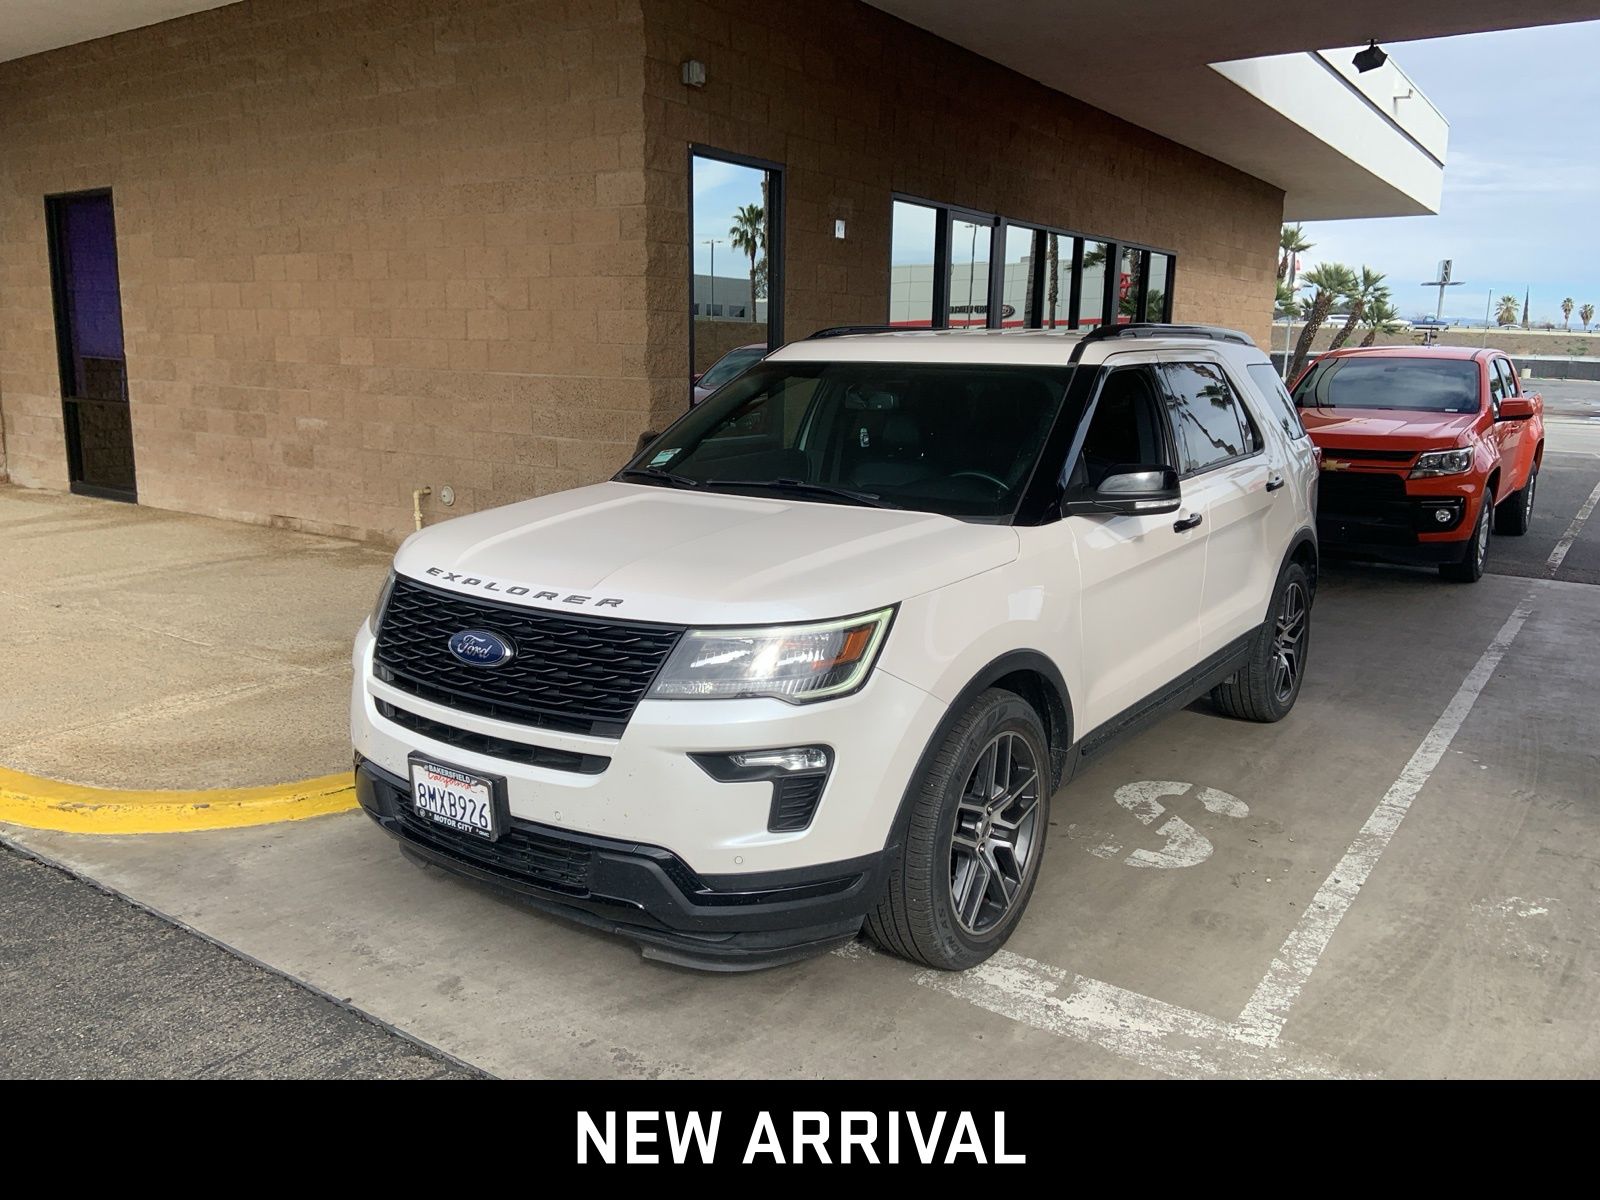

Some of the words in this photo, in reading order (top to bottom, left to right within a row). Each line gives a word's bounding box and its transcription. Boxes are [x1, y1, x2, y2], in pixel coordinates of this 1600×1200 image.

[426, 566, 624, 608] EXPLORER
[456, 633, 494, 660] Ford
[428, 764, 471, 784] BAKERSFIELD
[417, 783, 488, 829] 8MXB926
[433, 813, 456, 828] MOTOR
[457, 822, 473, 833] CITY
